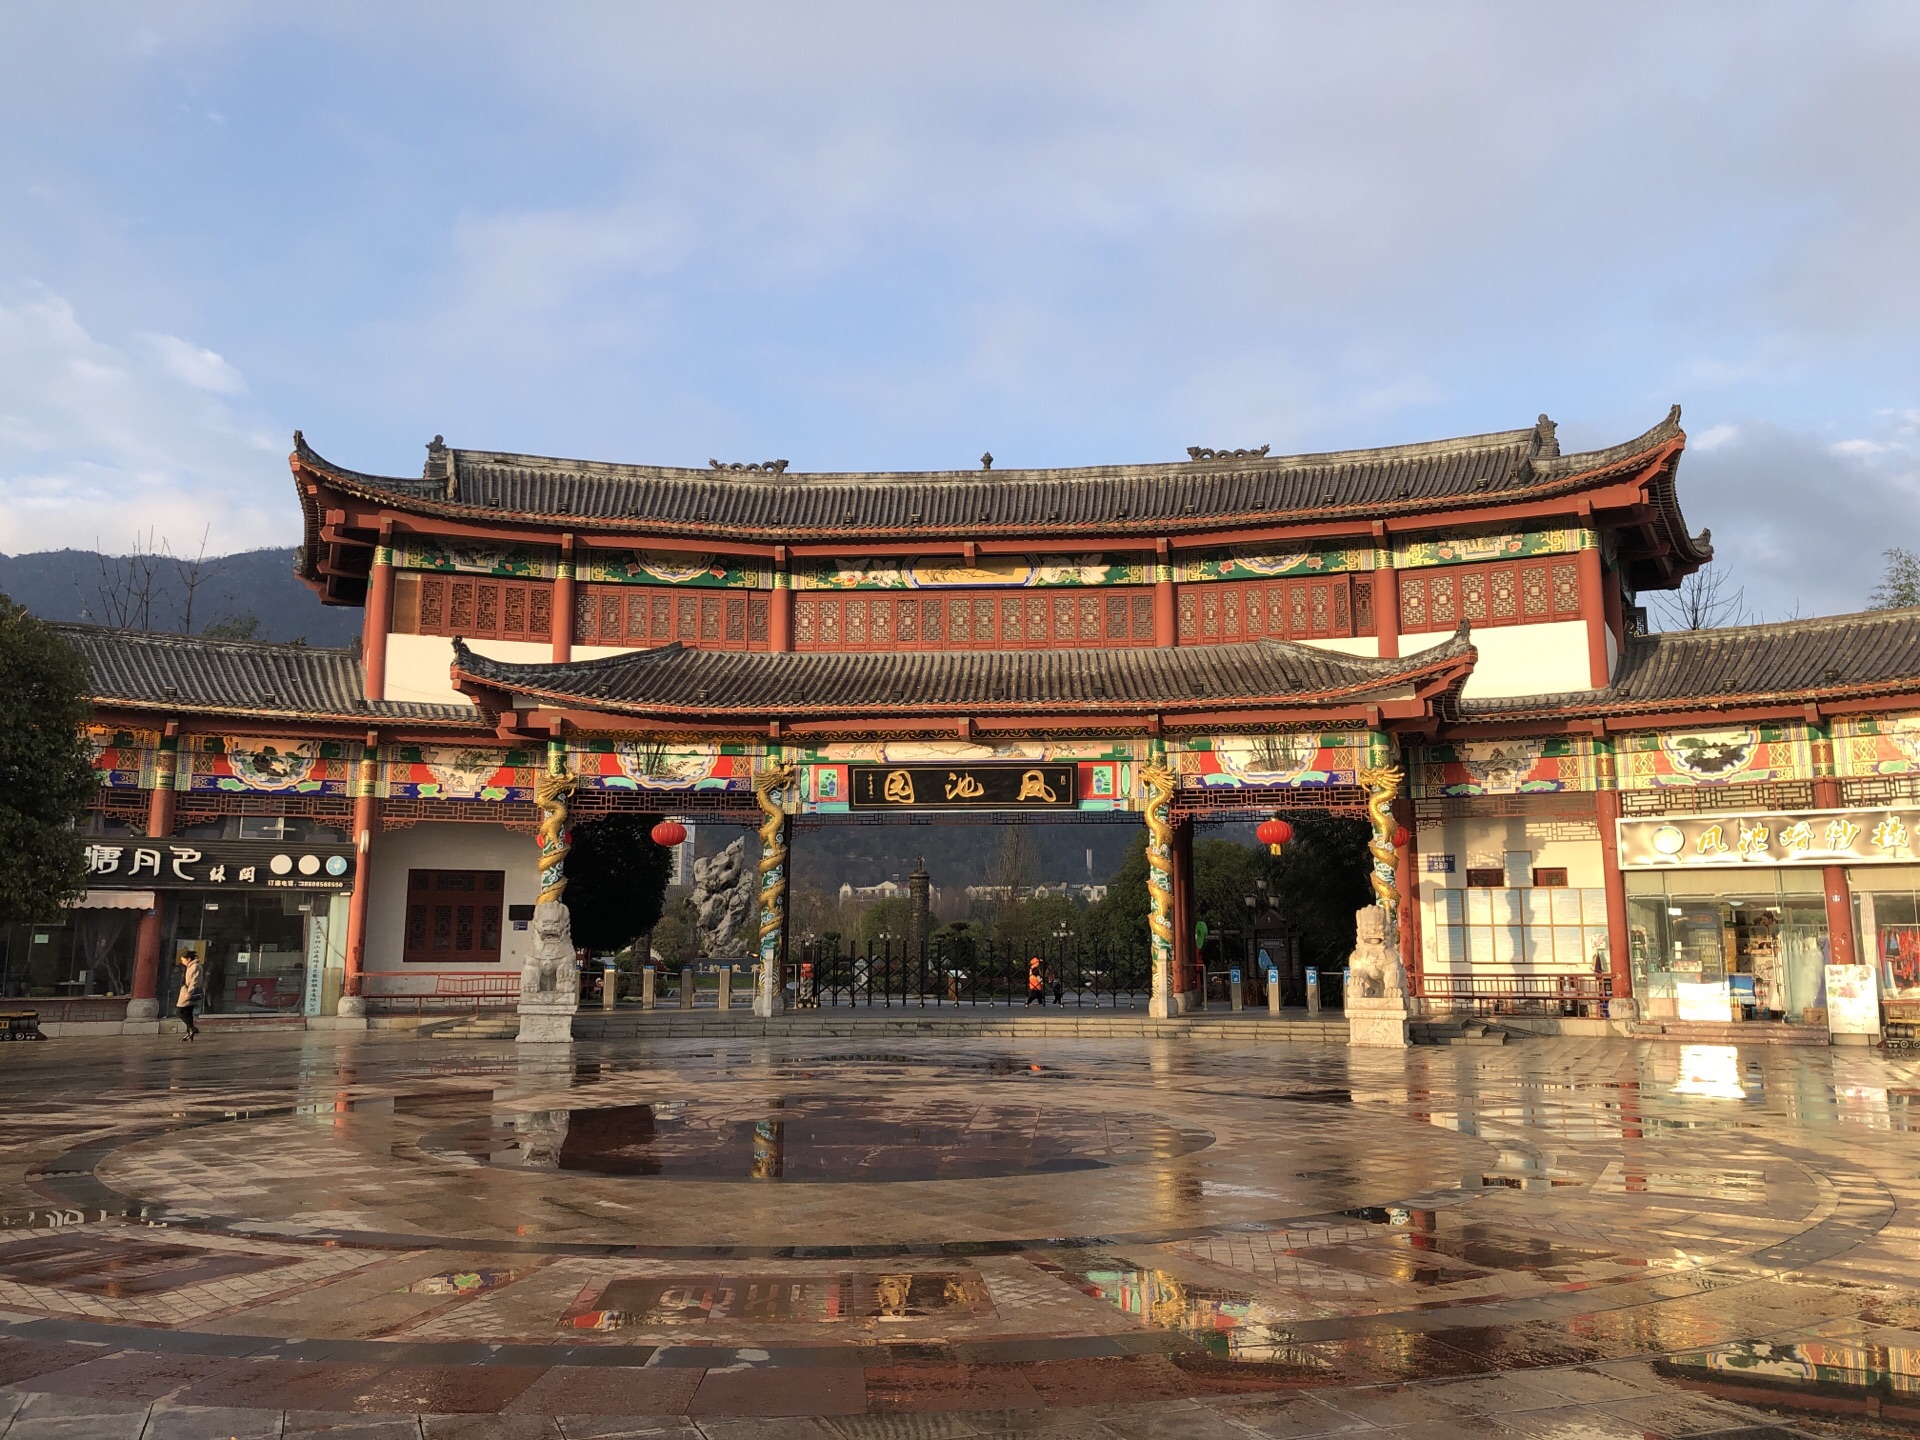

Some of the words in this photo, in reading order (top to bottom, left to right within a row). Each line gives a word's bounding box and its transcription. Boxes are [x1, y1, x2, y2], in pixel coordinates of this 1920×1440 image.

[1697, 817, 1920, 853] 凤池婚纱摄
